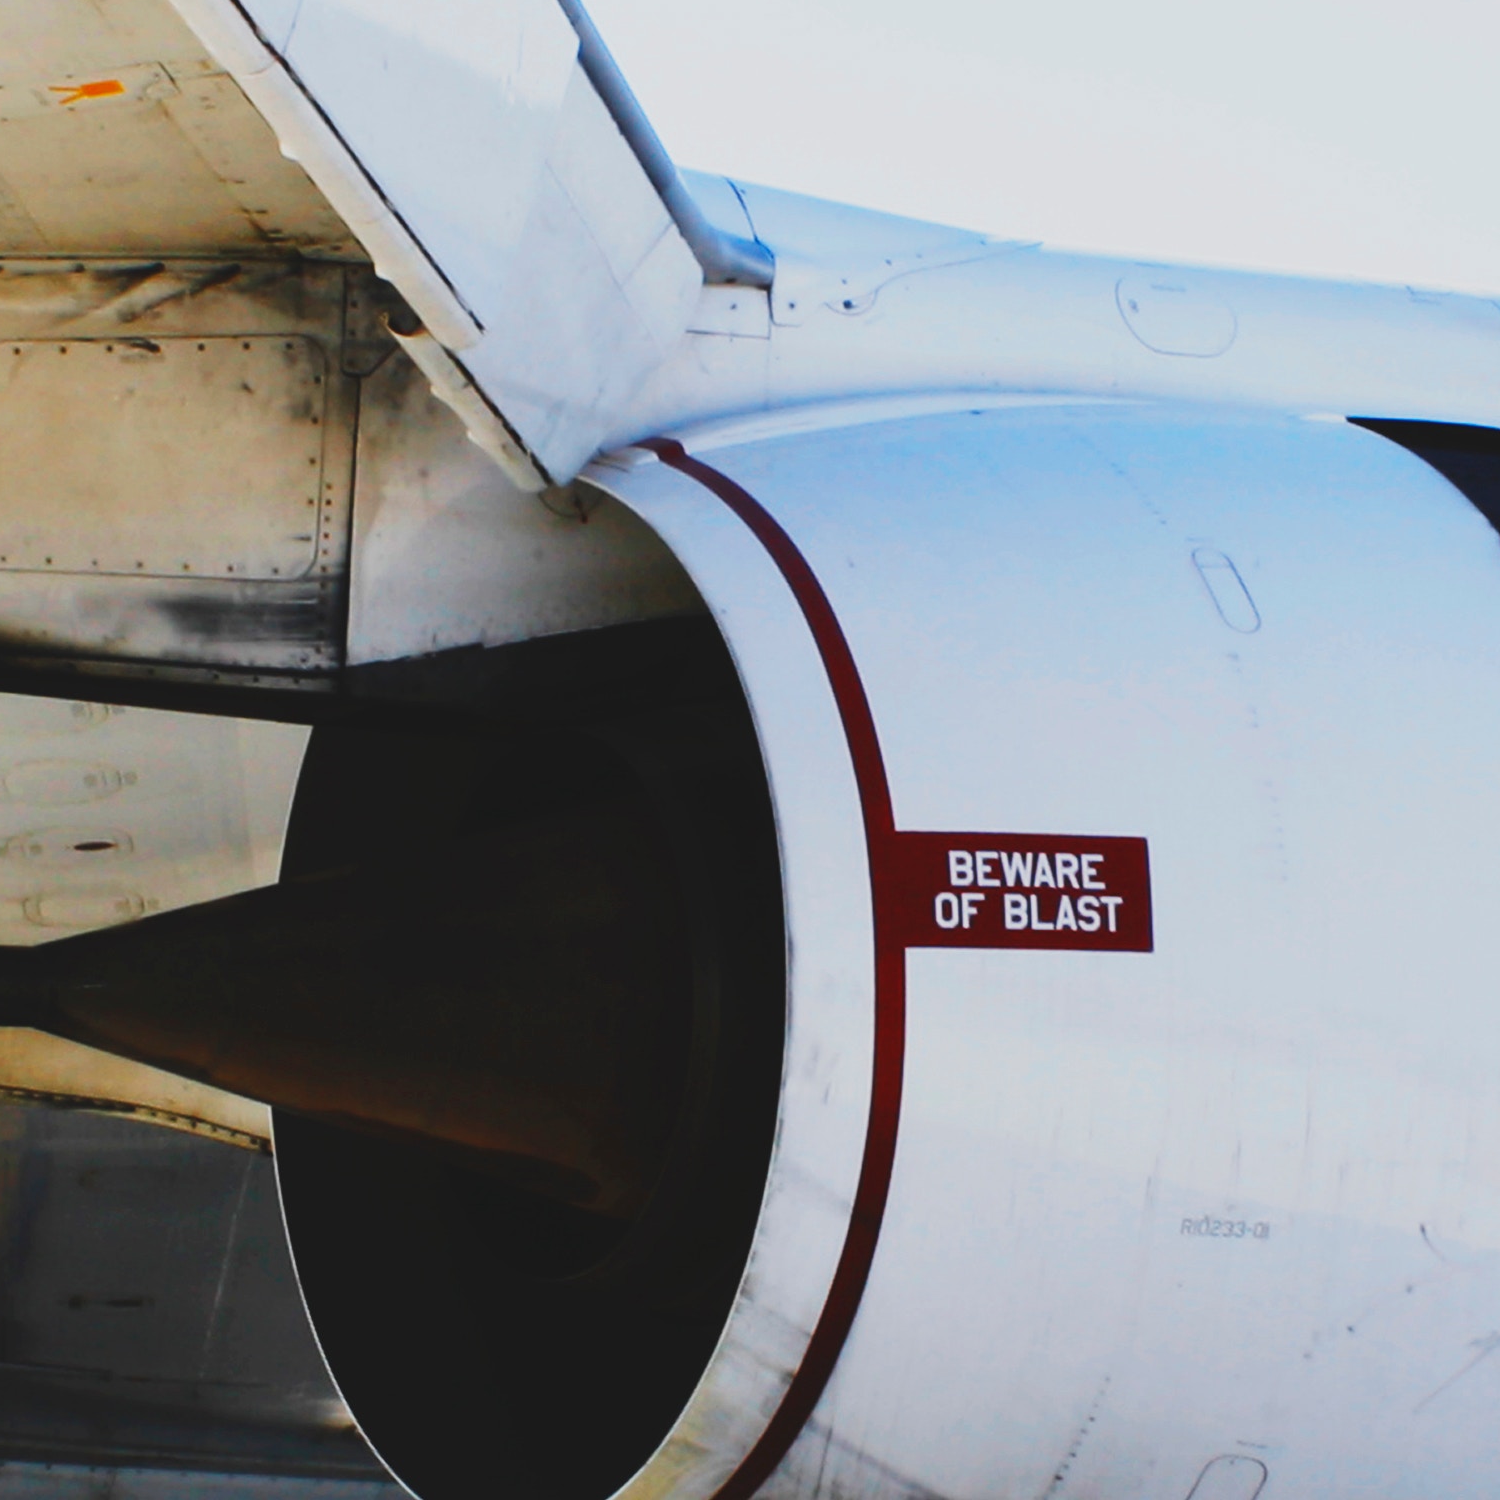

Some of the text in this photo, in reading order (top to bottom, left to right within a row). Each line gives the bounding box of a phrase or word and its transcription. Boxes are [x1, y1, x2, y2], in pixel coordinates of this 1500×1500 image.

[948, 850, 1106, 890] BEWARE
[934, 892, 1124, 932] OF BLAST
